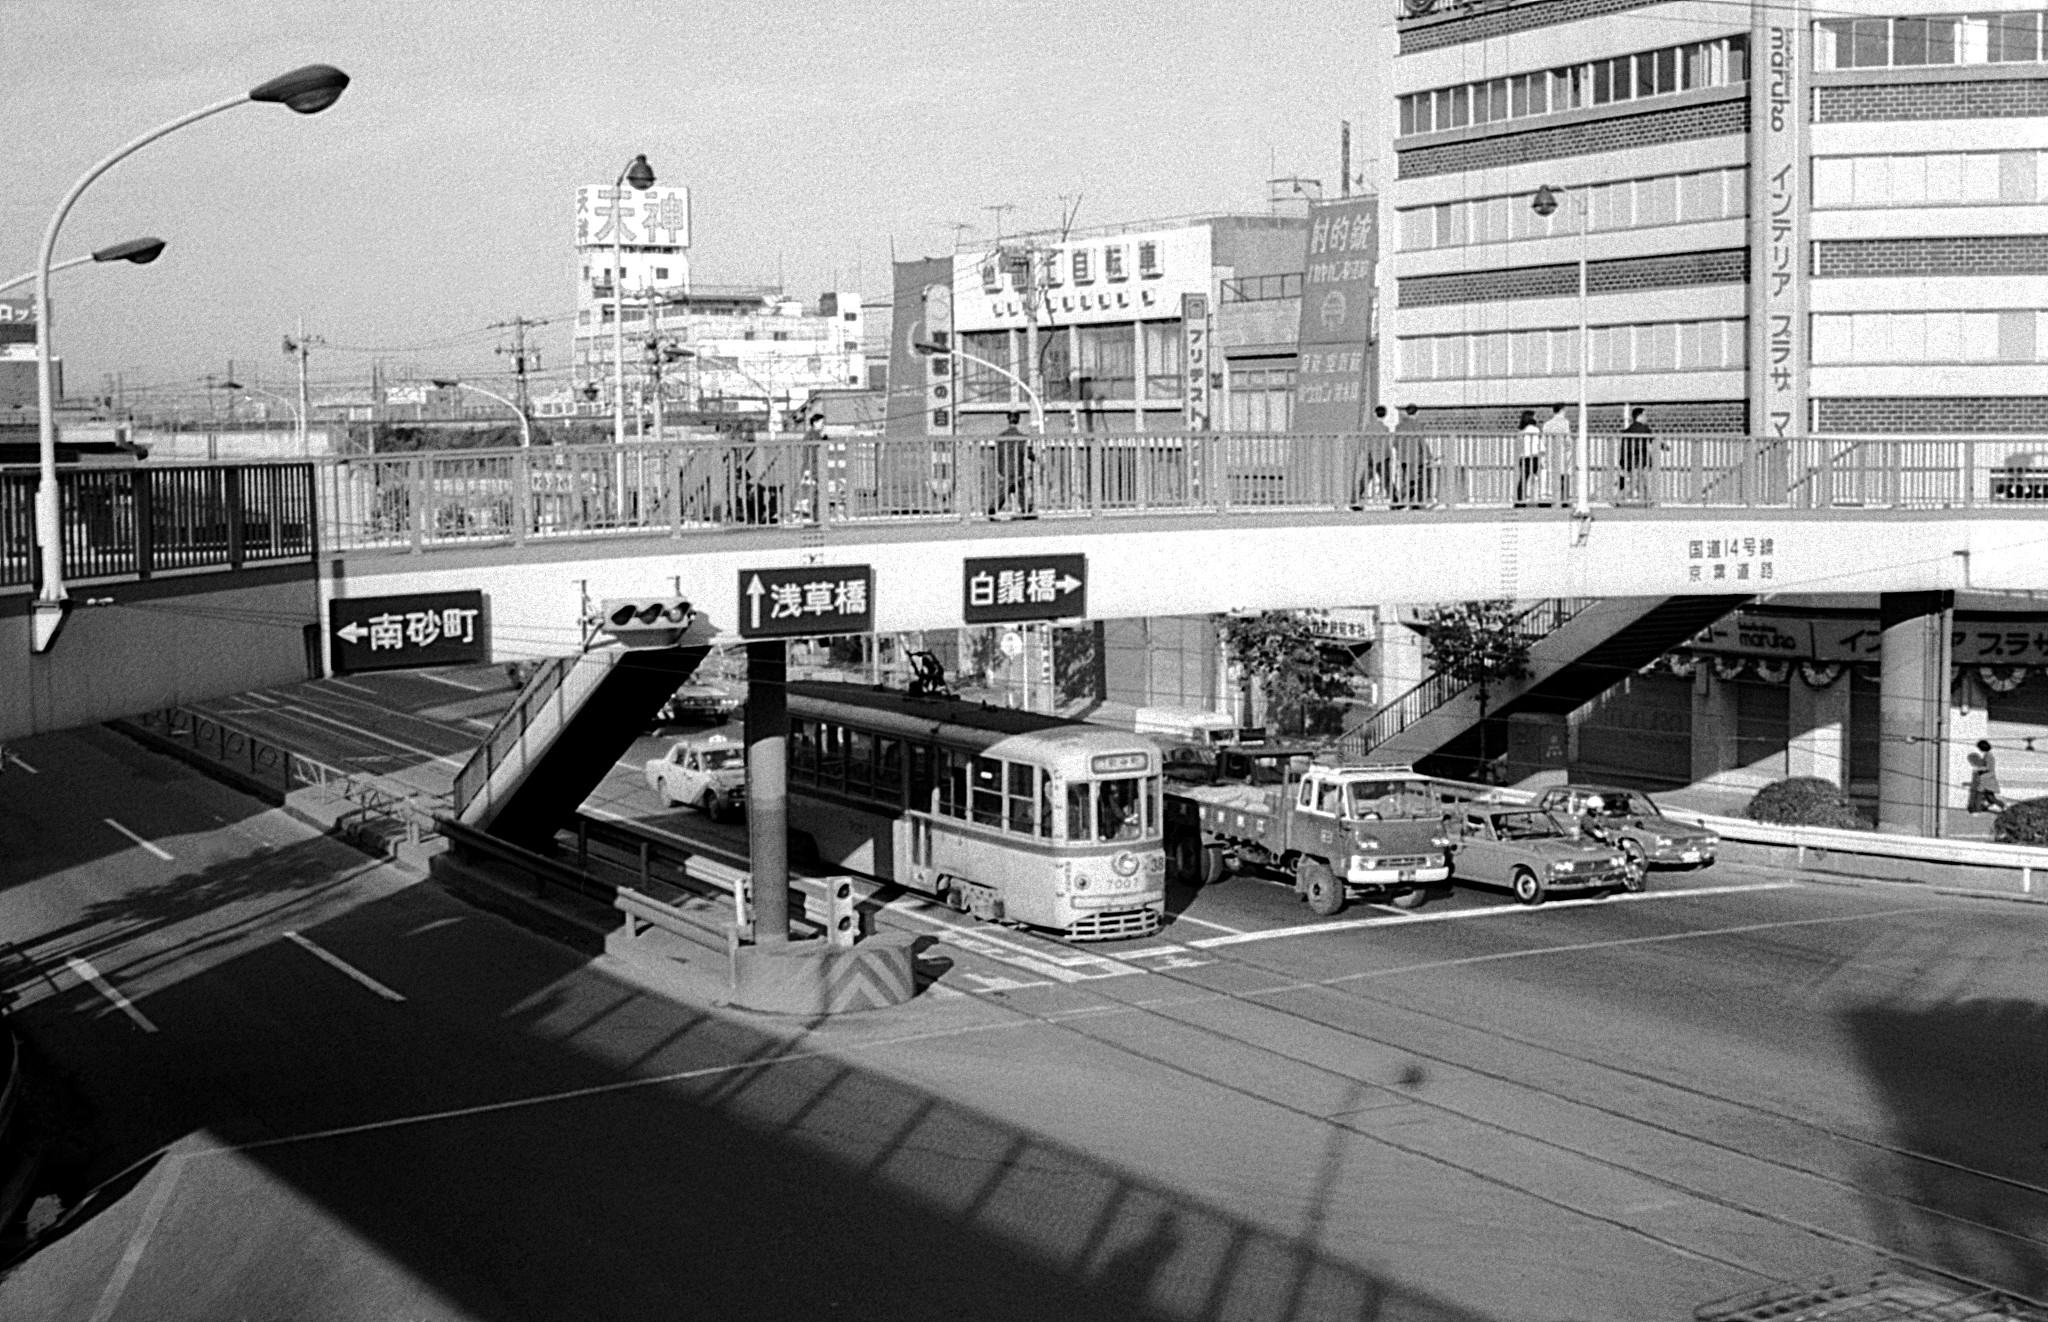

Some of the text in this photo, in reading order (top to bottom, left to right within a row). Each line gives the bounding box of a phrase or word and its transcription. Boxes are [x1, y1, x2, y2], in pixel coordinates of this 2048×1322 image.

[594, 189, 684, 243] 天神
[1772, 164, 1792, 297] インテリア
[770, 578, 867, 619] 浅草橋
[368, 609, 479, 651] 南砂町
